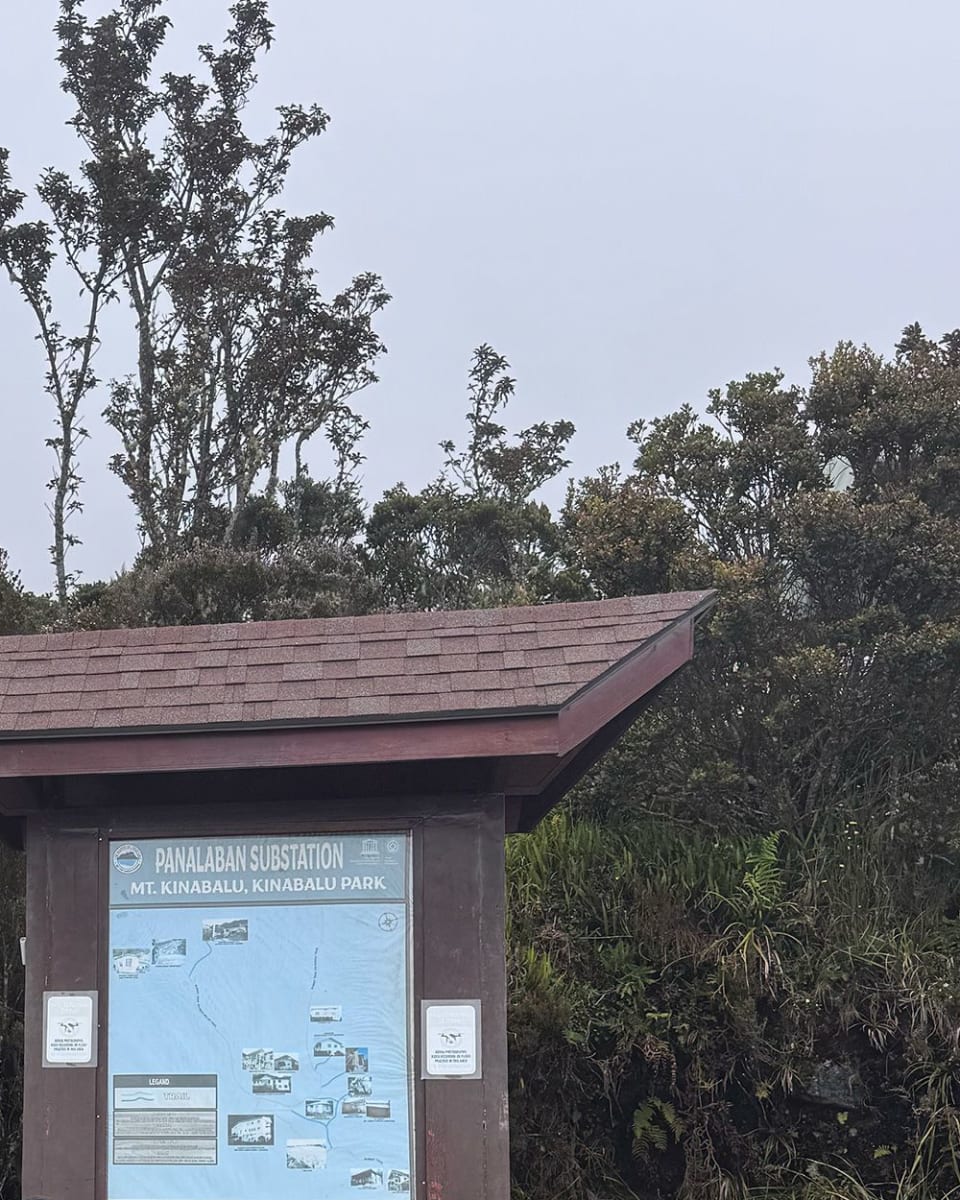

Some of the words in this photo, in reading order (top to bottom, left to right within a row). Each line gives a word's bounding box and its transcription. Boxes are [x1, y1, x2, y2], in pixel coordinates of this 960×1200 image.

[155, 844, 246, 873] PANALABAN
[249, 842, 343, 872] SUBSTATION
[130, 881, 157, 895] MT.
[160, 879, 248, 895] KINABALU,
[252, 877, 337, 893] KINABALU
[340, 876, 387, 890] PARK
